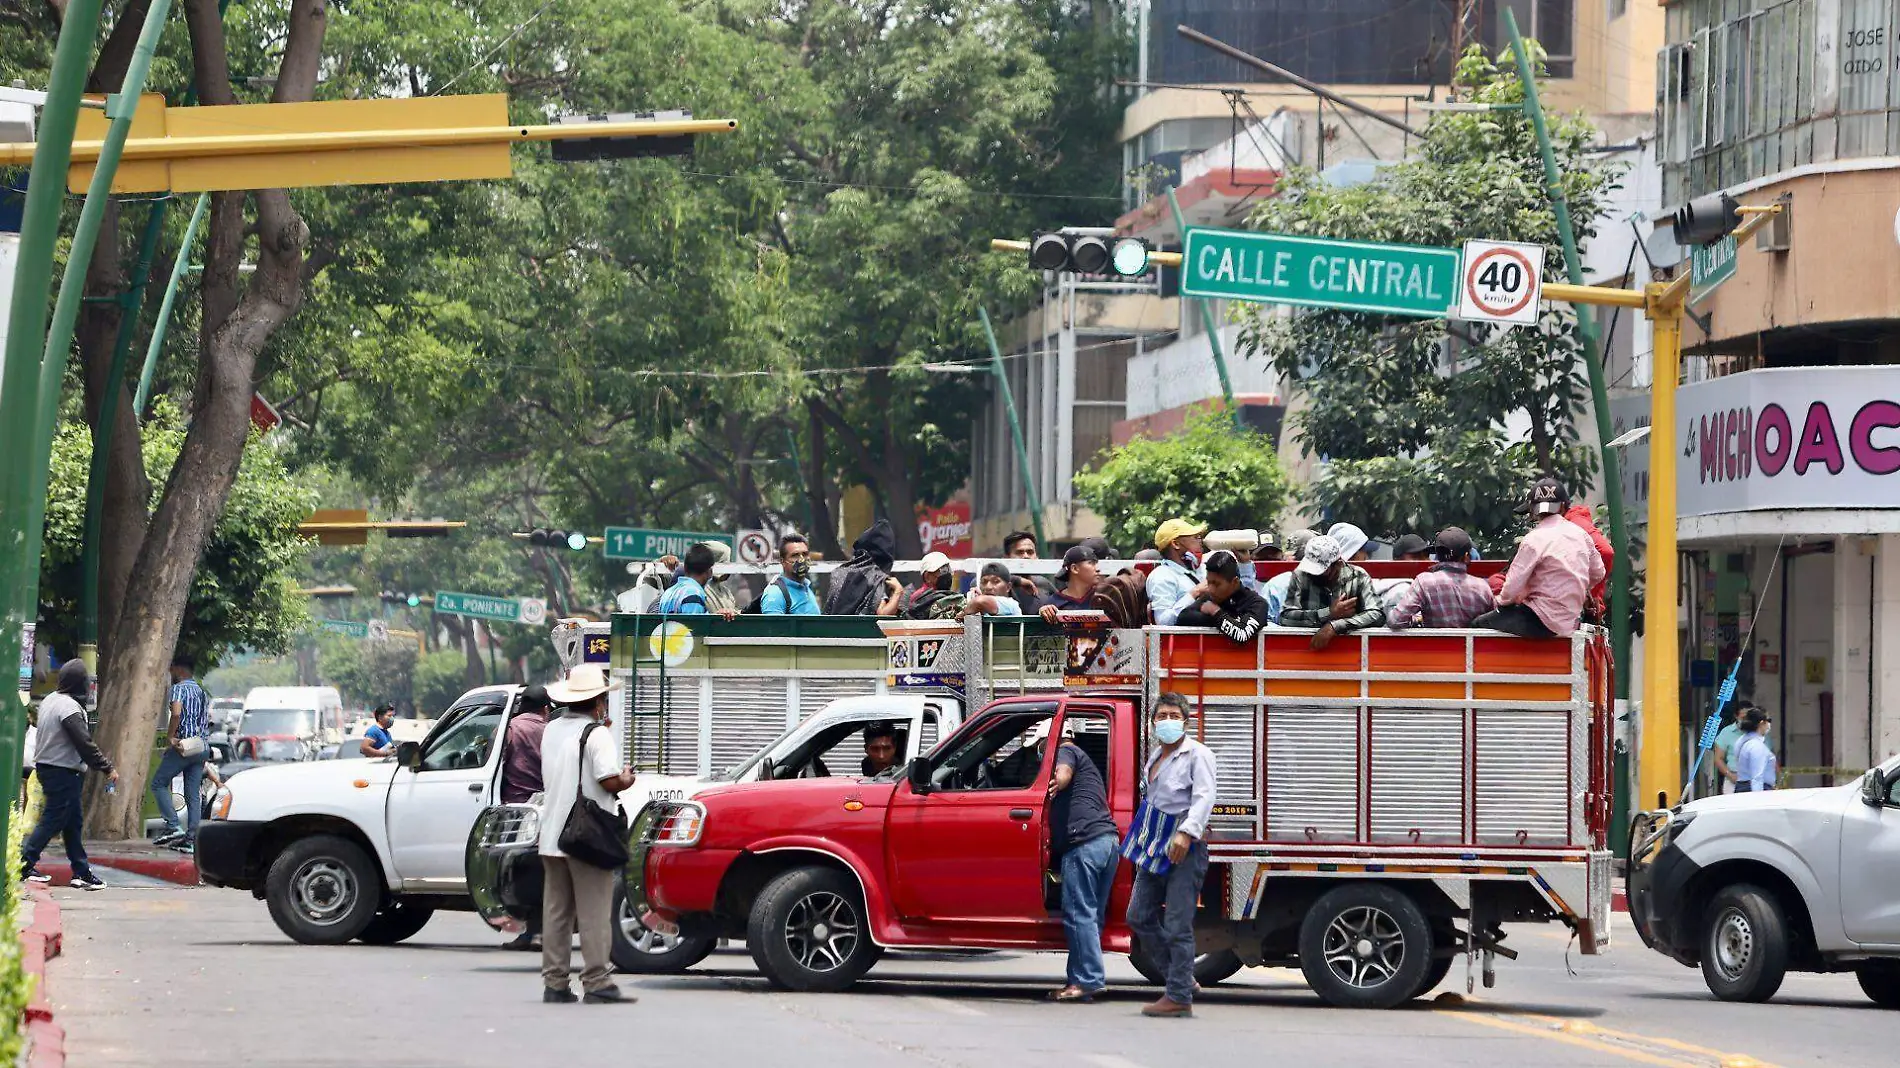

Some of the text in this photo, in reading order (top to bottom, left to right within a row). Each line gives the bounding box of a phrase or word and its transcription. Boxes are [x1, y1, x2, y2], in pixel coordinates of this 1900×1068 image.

[1845, 27, 1884, 48] JOSE
[1844, 57, 1882, 75] OIDO
[1197, 244, 1443, 301] CALLE CENTRAL
[1478, 261, 1522, 293] 40
[645, 535, 698, 556] PONIE
[462, 598, 516, 618] PONIENTE
